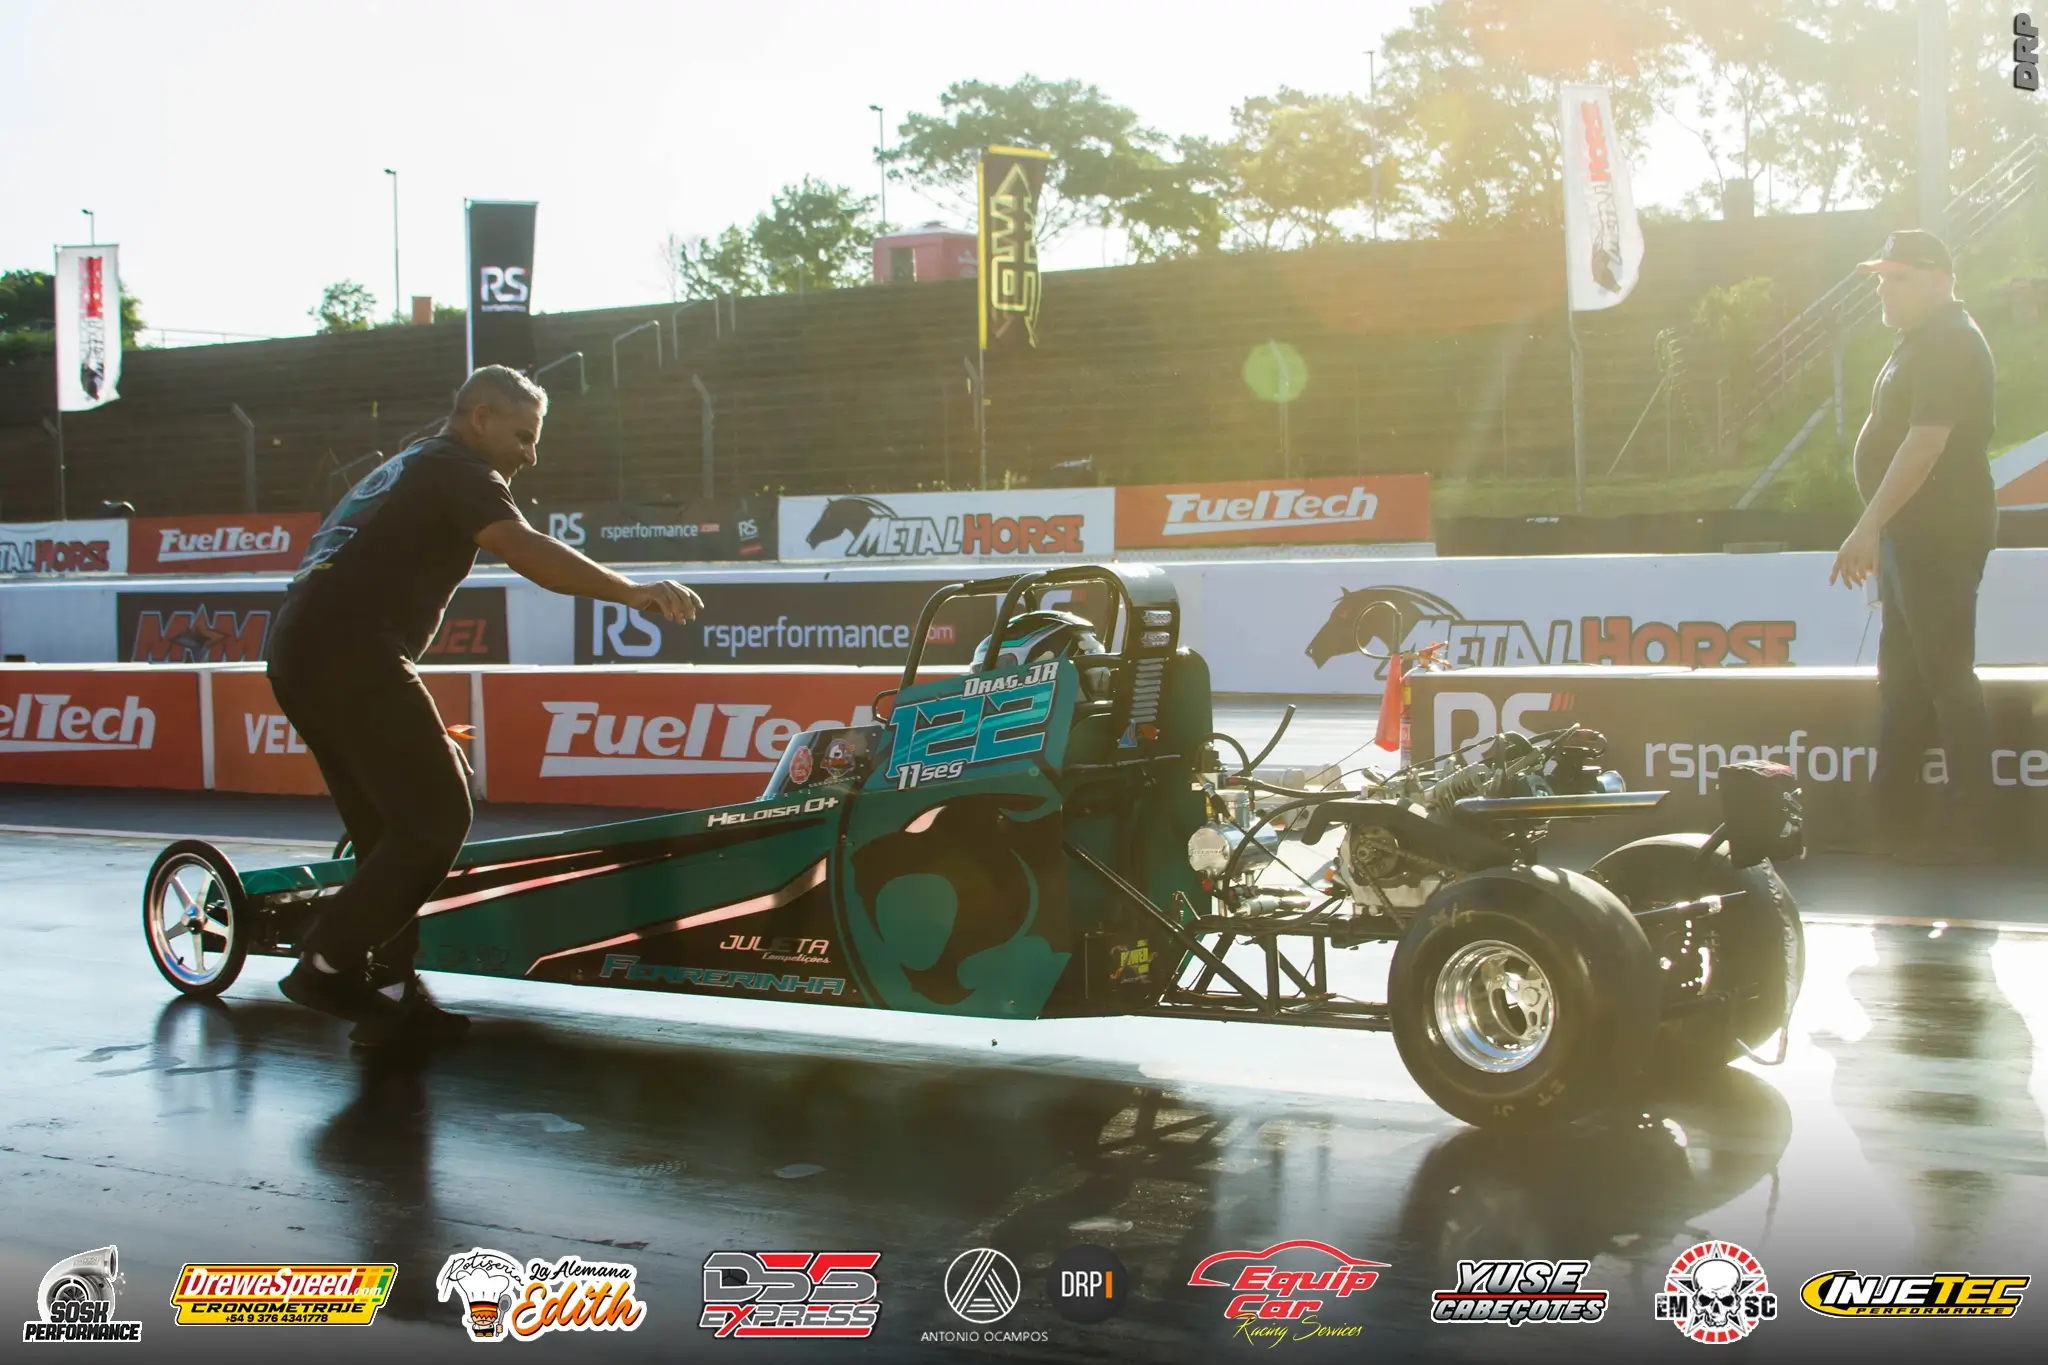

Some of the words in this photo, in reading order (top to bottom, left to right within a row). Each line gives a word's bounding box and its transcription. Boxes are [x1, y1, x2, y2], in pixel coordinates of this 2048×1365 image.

[480, 266, 529, 303] RS
[550, 512, 586, 546] RS
[1163, 486, 1378, 524] FuelTech
[158, 525, 291, 553] FuelTech
[593, 599, 662, 657] RS
[541, 702, 886, 760] FuelTe
[886, 680, 1056, 778] 122
[1645, 730, 2048, 796] rsperforace
